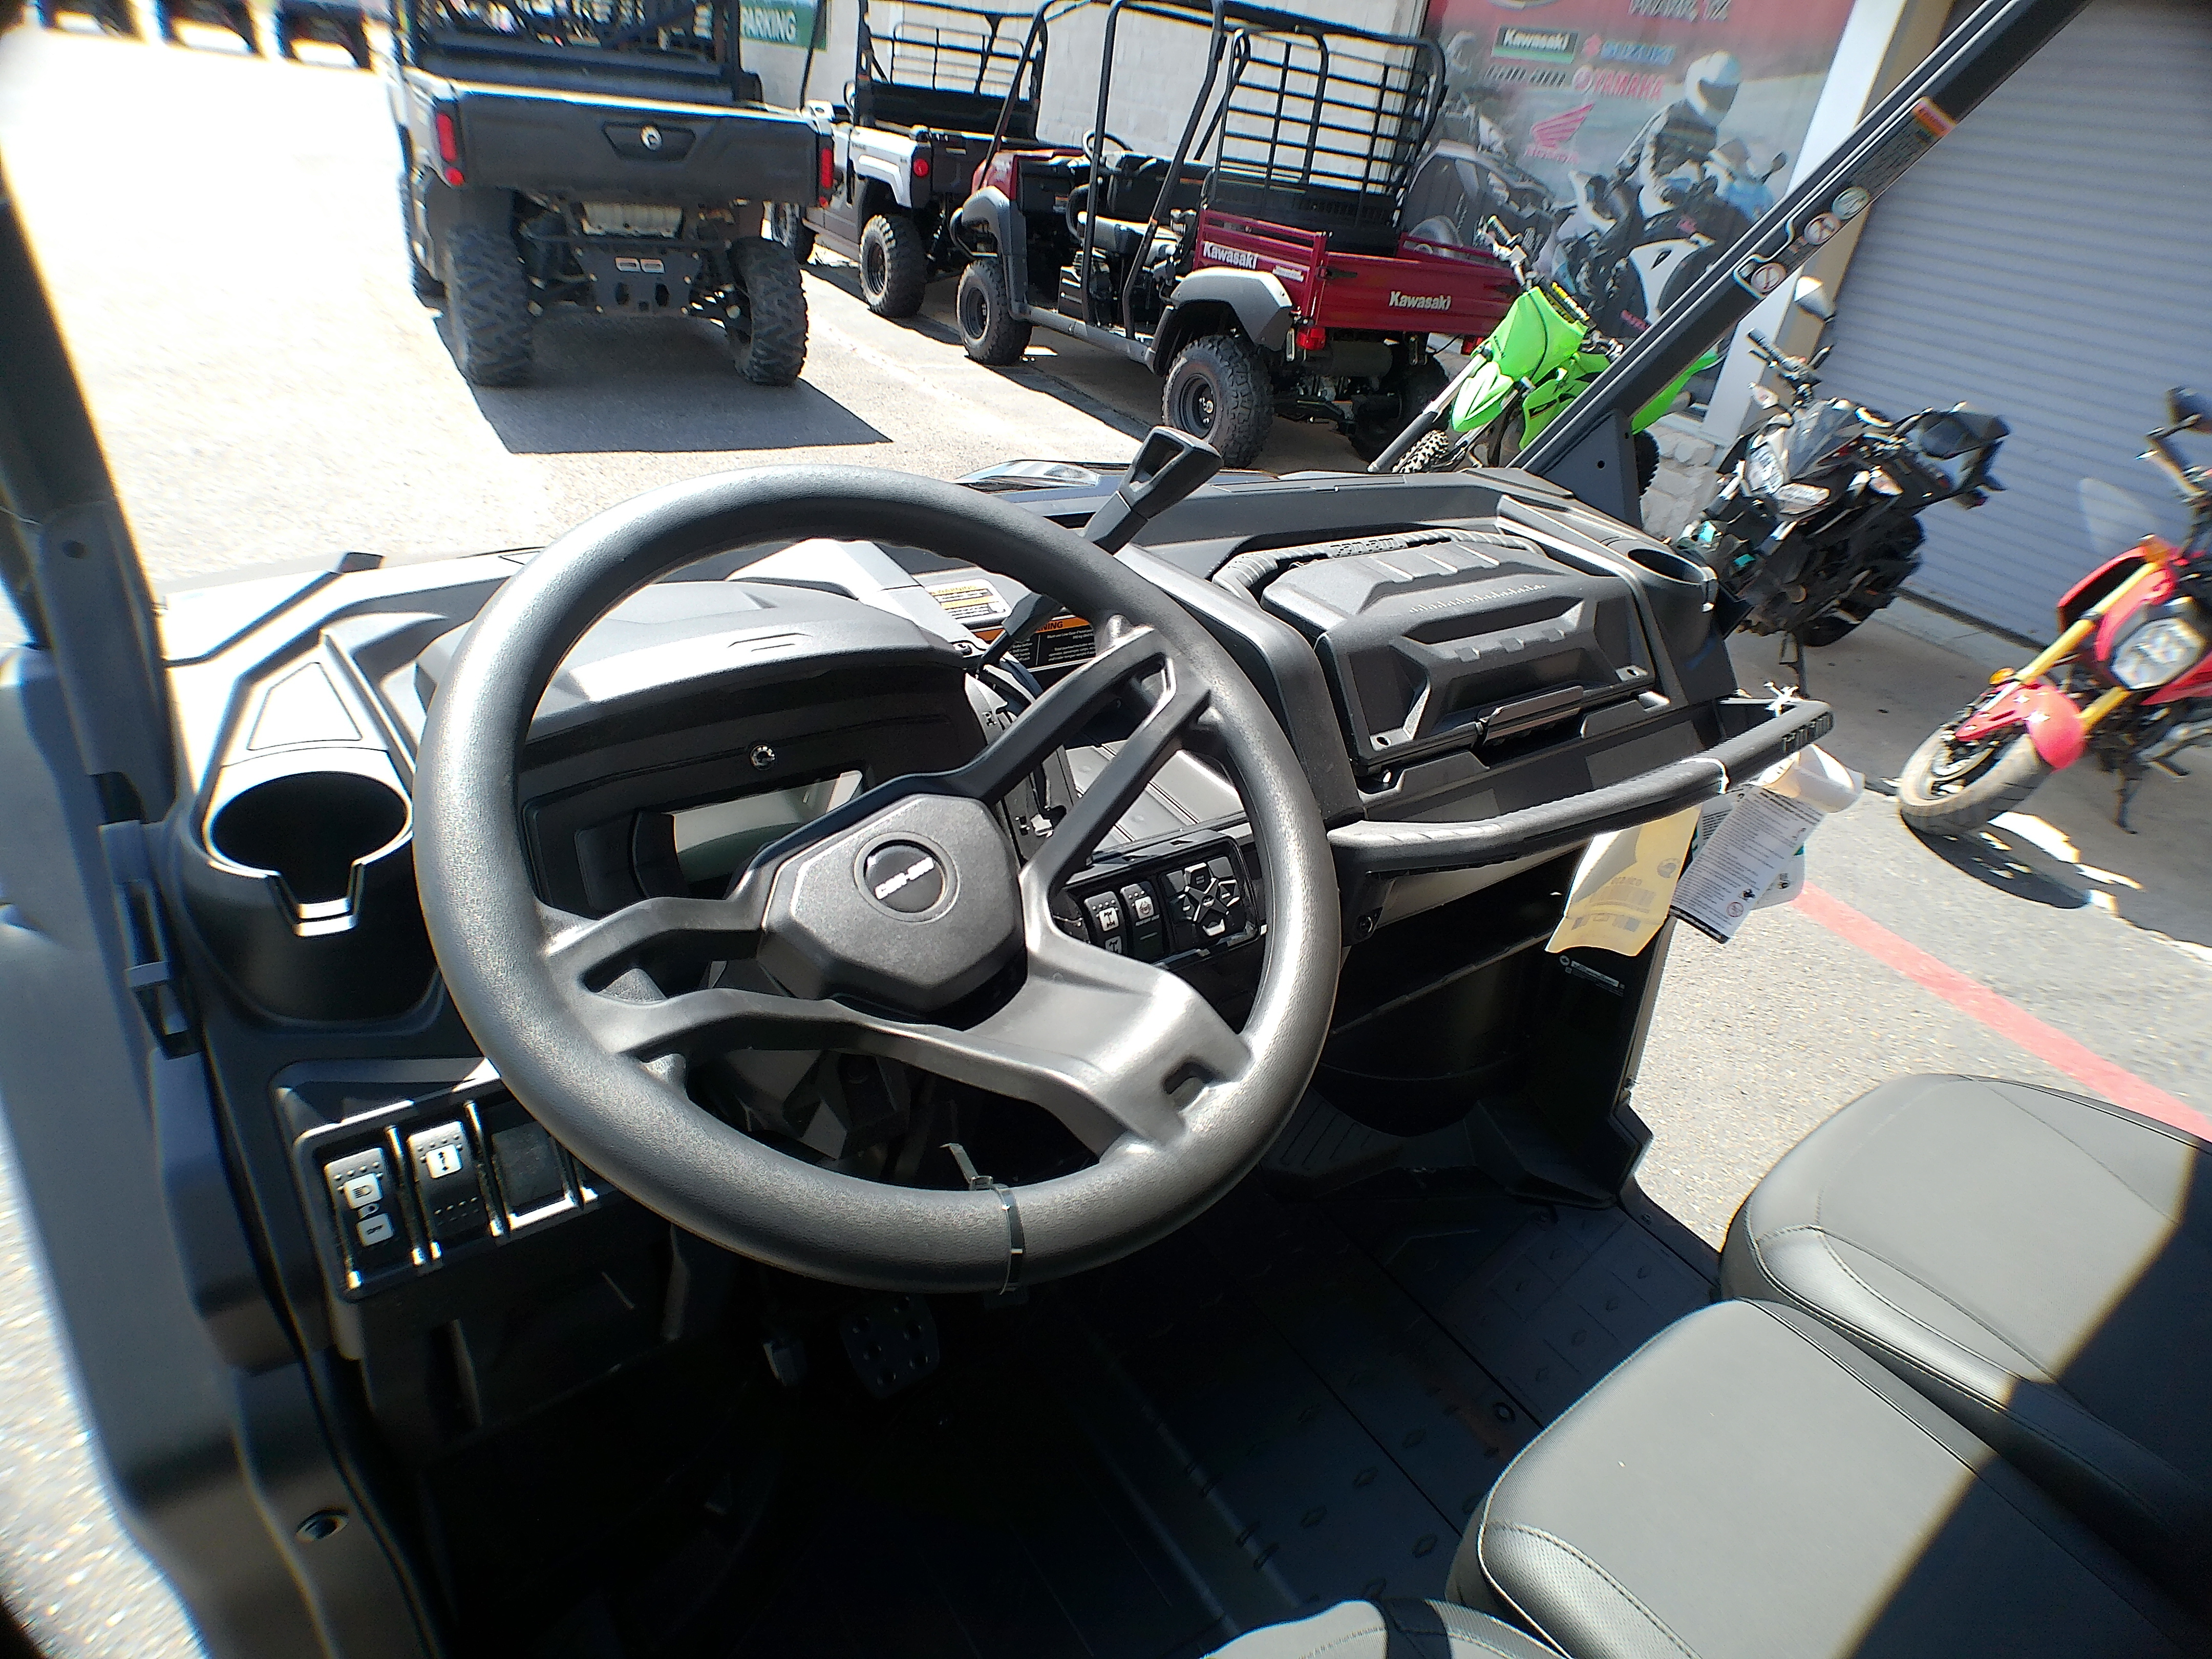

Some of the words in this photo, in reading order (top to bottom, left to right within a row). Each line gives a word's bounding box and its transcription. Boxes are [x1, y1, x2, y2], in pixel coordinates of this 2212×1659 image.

[1593, 68, 1665, 101] YAMAHA
[1203, 242, 1259, 270] Kawasaki
[1389, 291, 1452, 310] Kawasaki
